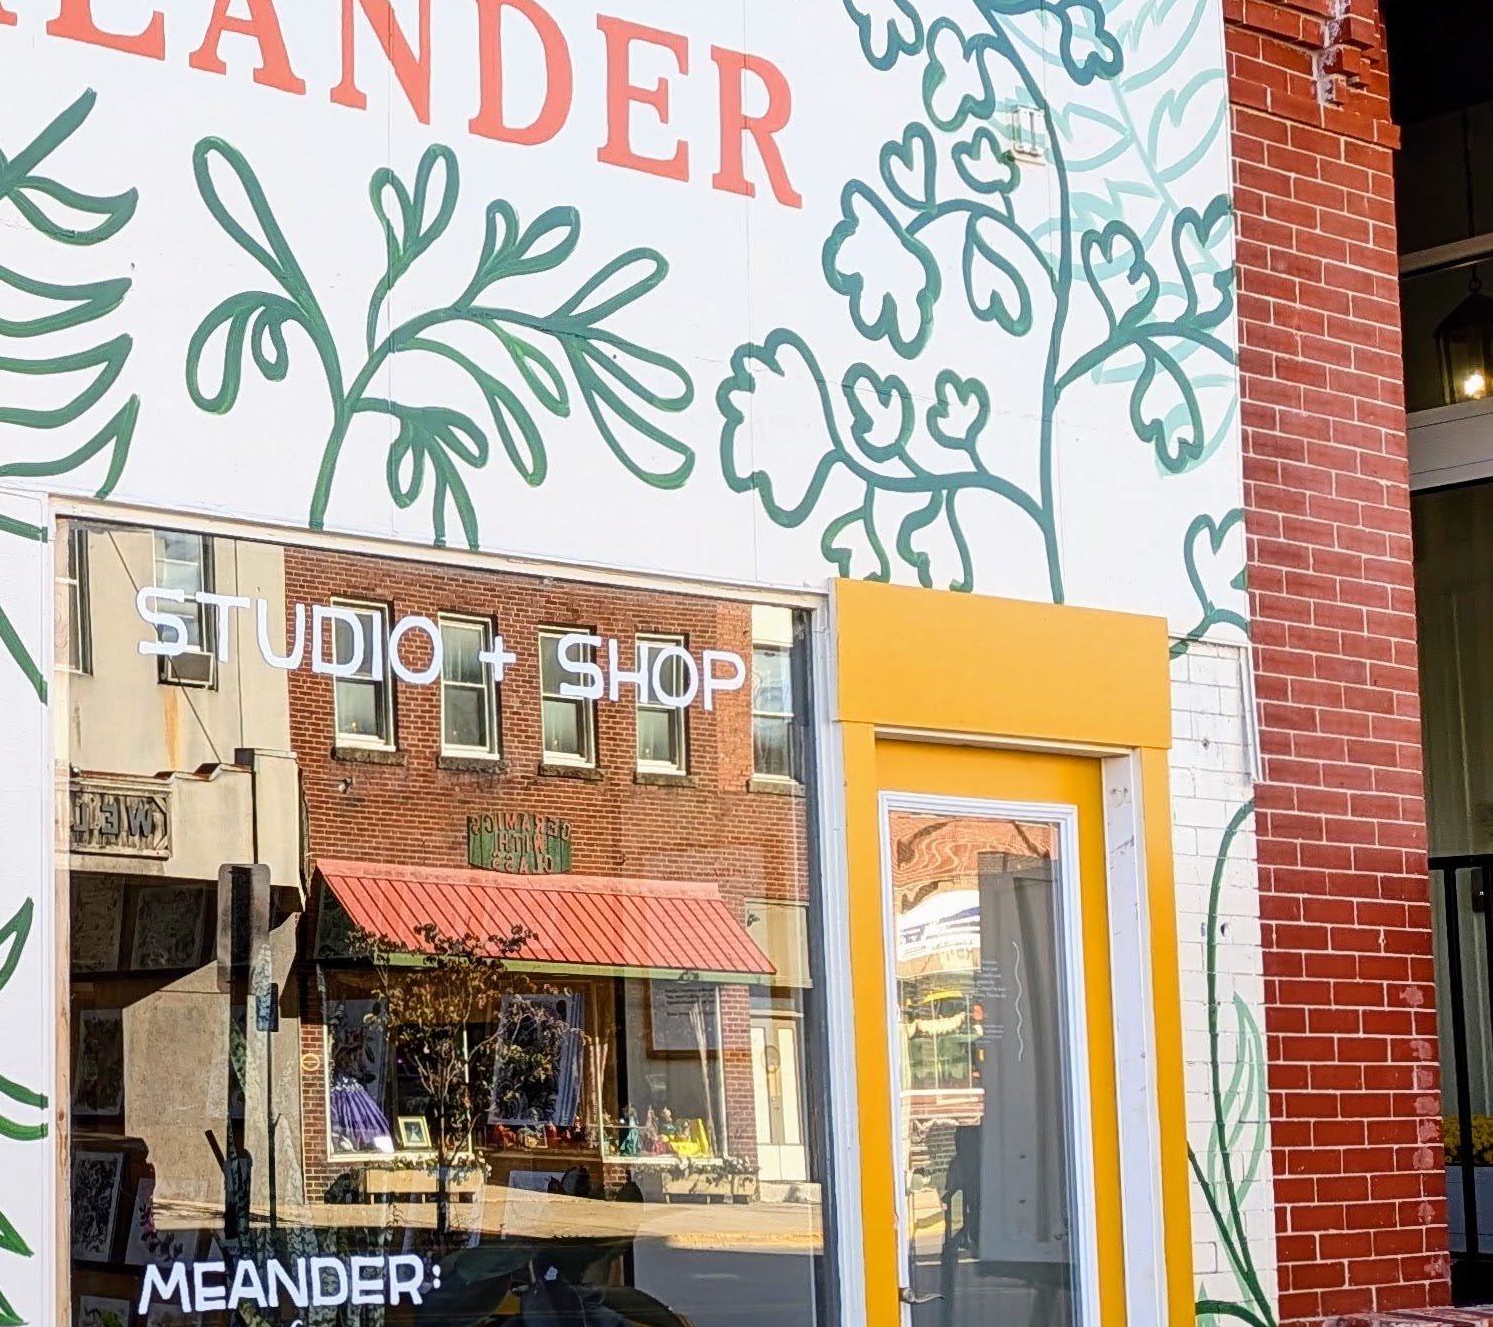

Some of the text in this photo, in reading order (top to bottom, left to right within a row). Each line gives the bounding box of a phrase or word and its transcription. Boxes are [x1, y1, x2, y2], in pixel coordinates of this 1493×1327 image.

[136, 585, 443, 685] STUDIO
[558, 632, 746, 711] SHOP
[138, 1253, 442, 1316] MEANDER:
